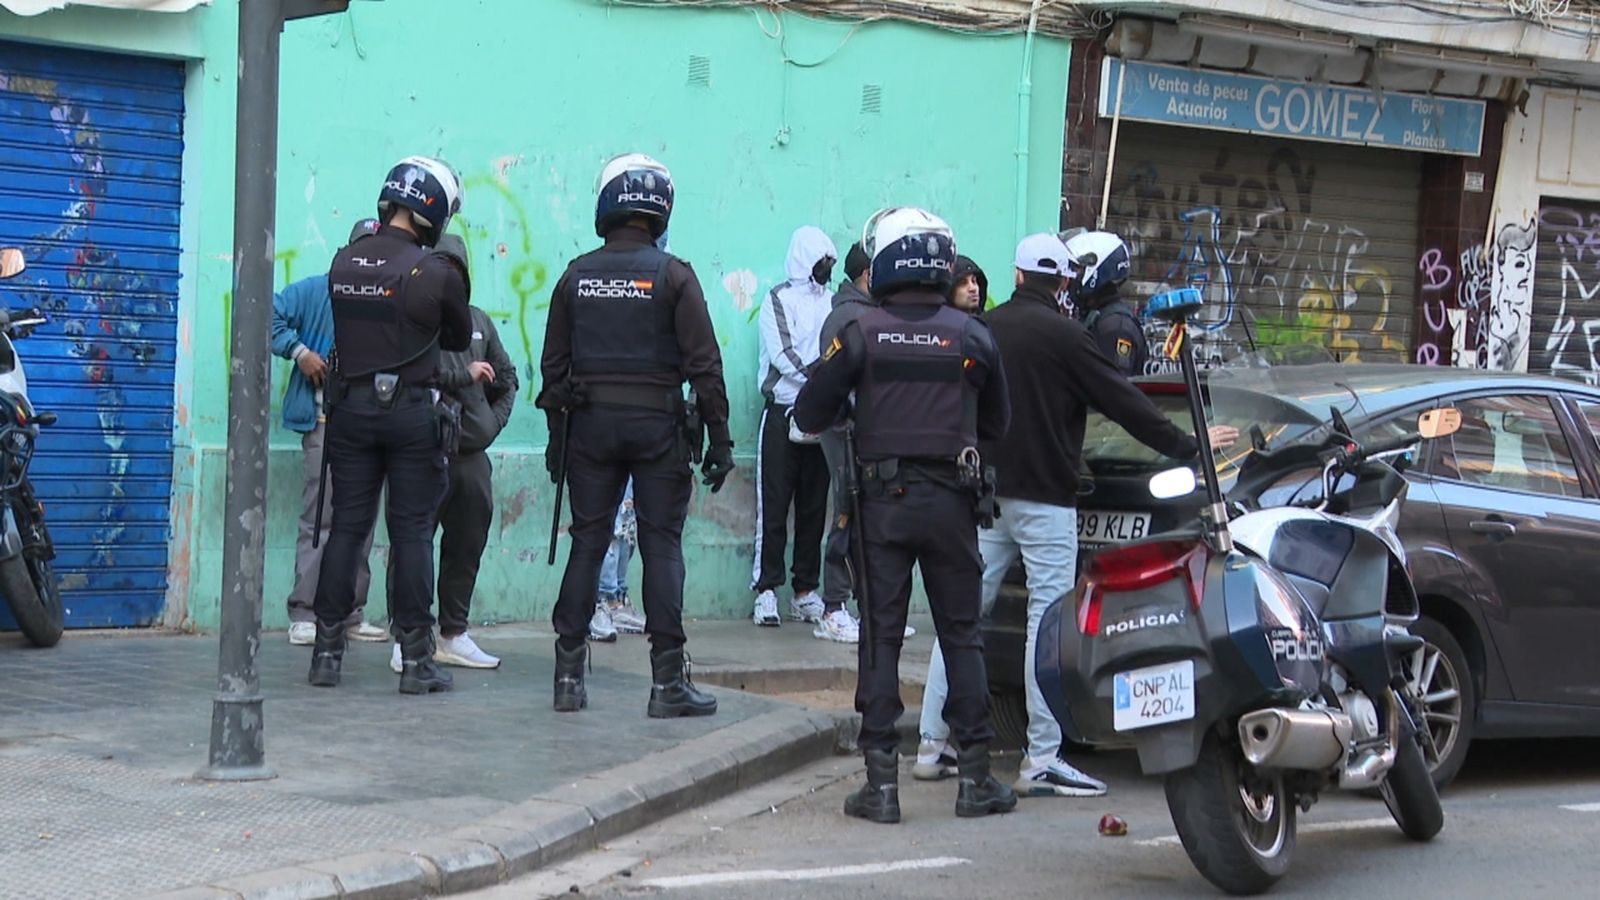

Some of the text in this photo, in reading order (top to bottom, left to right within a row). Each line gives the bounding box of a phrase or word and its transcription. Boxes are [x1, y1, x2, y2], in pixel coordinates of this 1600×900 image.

[1148, 73, 1249, 103] Venta de peces
[1165, 96, 1228, 121] Acuarios
[1254, 83, 1388, 143] GOMEZ
[1411, 97, 1446, 117] Flors
[895, 257, 951, 272] POLICIA
[577, 288, 653, 300] NACIONAL
[1103, 514, 1146, 540] KLB
[1105, 613, 1180, 636] POLICIA
[1132, 671, 1190, 698] CNP AL
[1140, 695, 1185, 718] 4204
